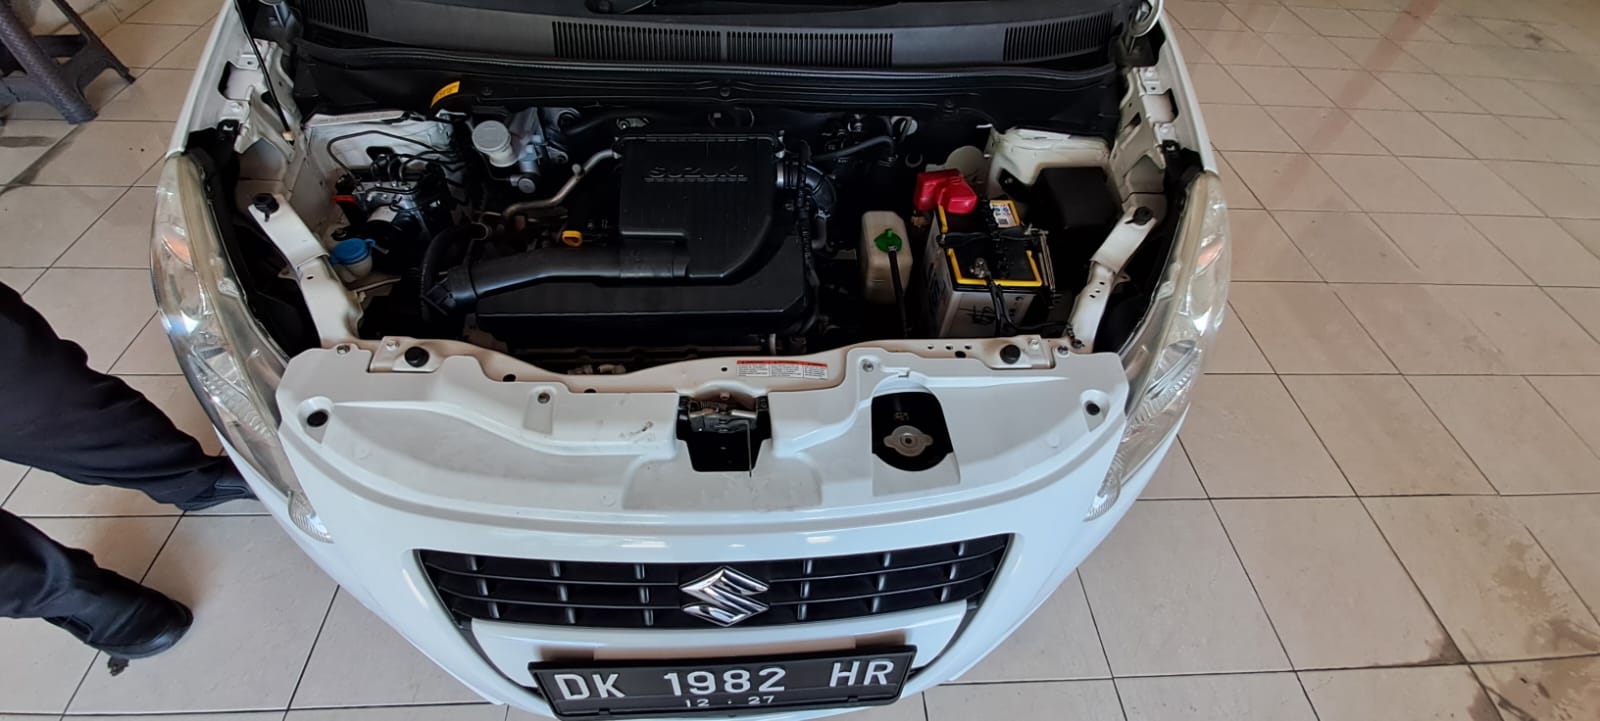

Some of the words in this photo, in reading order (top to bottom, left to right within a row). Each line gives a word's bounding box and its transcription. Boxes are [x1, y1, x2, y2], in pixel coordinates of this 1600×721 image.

[649, 166, 745, 178] SUZUKI
[554, 673, 625, 700] DK
[663, 667, 786, 696] 1982
[828, 660, 895, 687] HR
[685, 698, 710, 708] 12
[747, 695, 775, 705] 27
